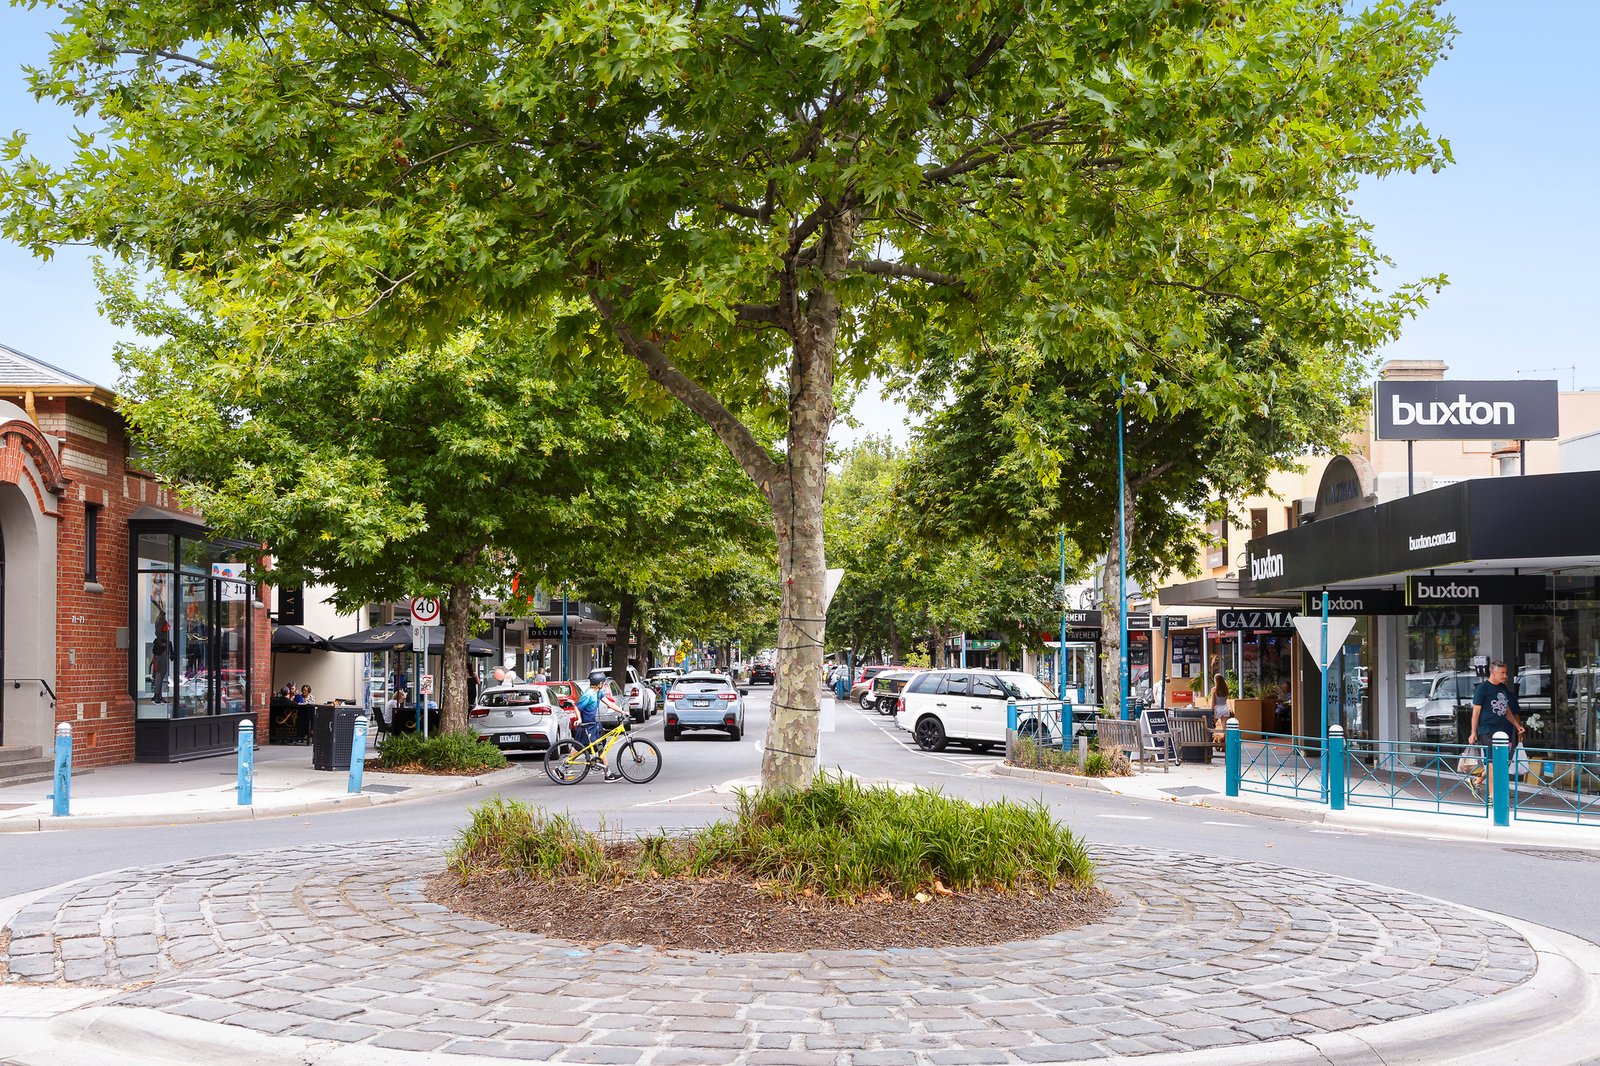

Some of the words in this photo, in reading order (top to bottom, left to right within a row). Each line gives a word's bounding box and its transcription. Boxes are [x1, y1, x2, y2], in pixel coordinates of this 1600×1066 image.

[1391, 394, 1515, 426] buxton
[1409, 530, 1456, 551] buxton.com.au
[1251, 549, 1284, 581] buxton
[1418, 582, 1479, 599] buxton
[416, 601, 435, 614] 40
[1067, 631, 1099, 639] PAVEMENT
